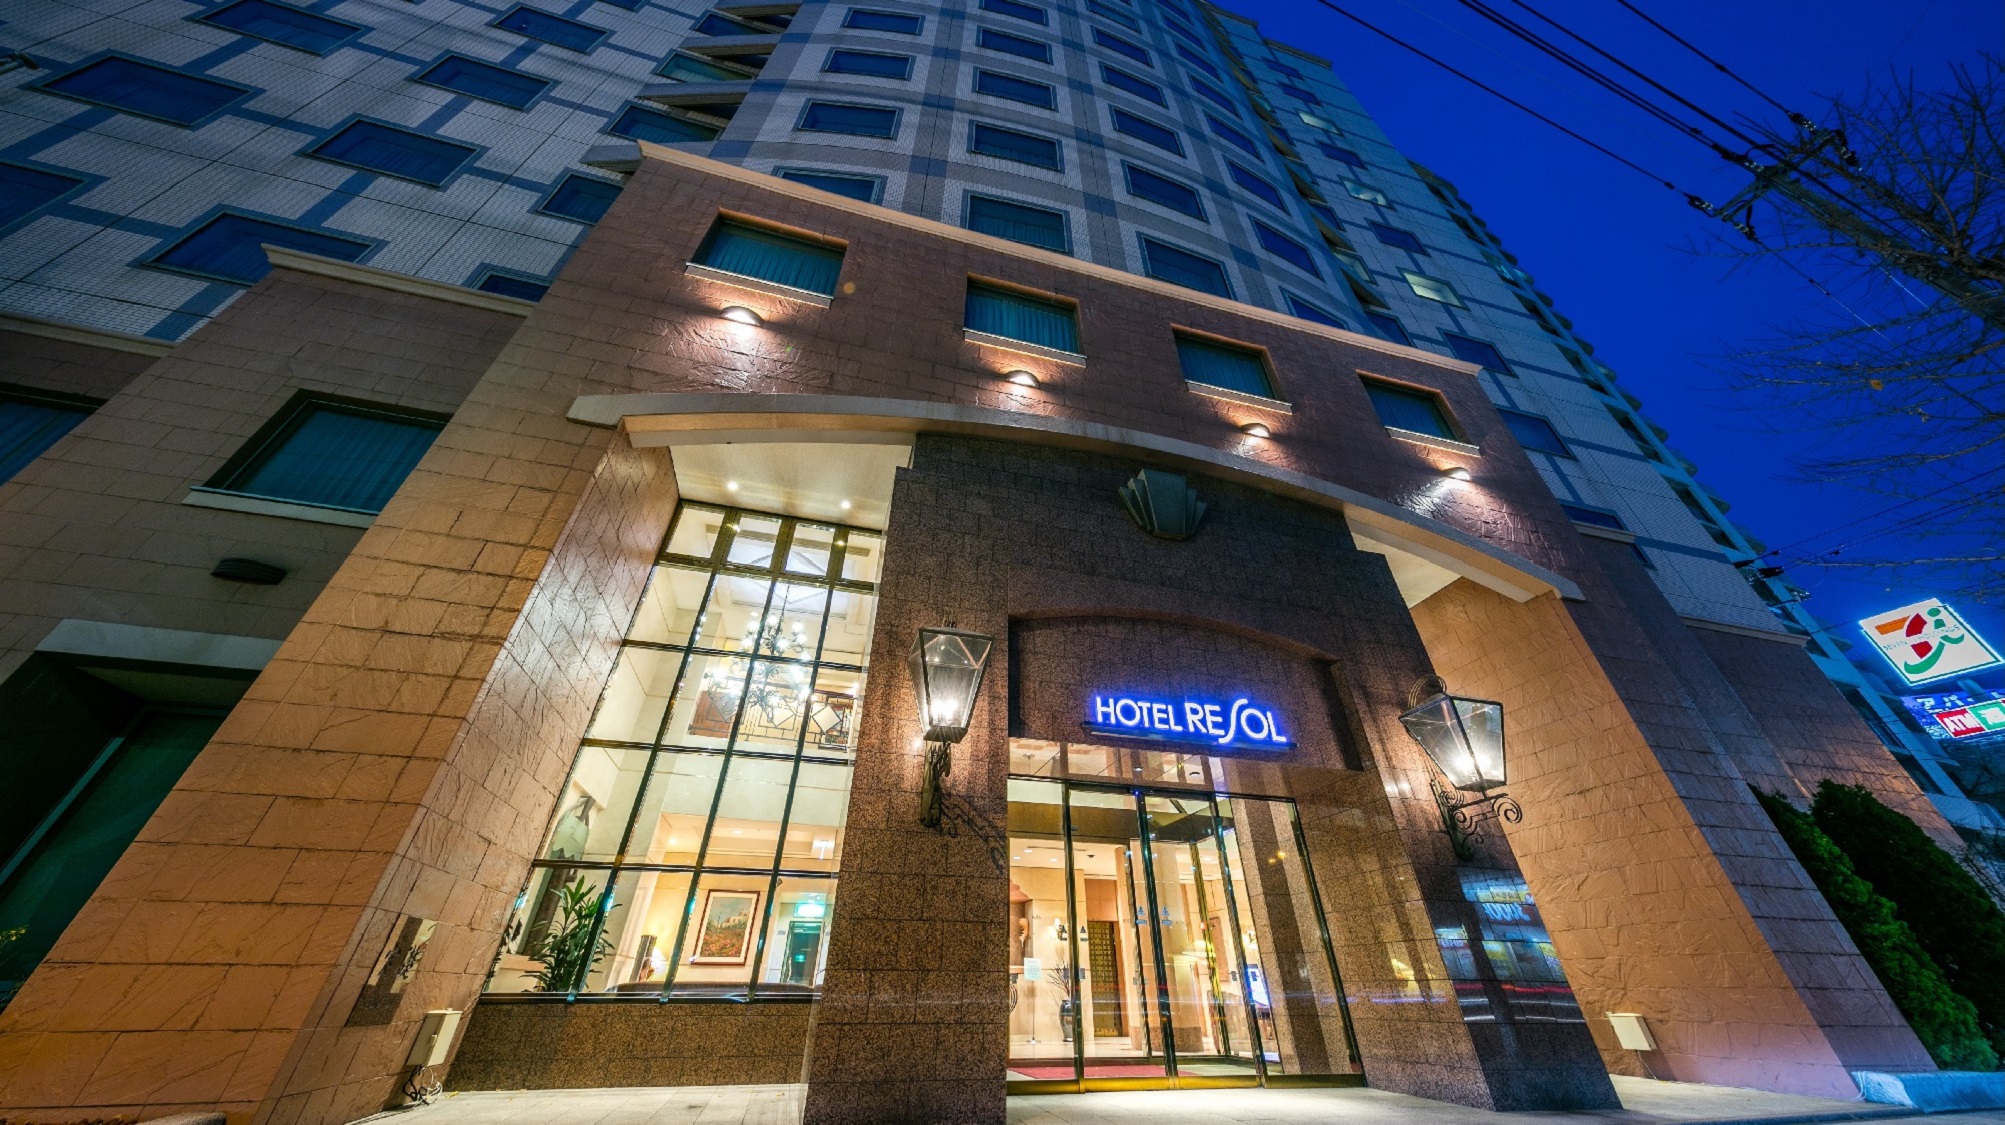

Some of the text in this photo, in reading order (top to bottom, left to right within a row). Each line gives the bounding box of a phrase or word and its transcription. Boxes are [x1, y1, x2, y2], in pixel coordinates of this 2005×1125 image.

[1096, 696, 1286, 743] HOTEL RESOL
[1942, 712, 1980, 733] ATM
